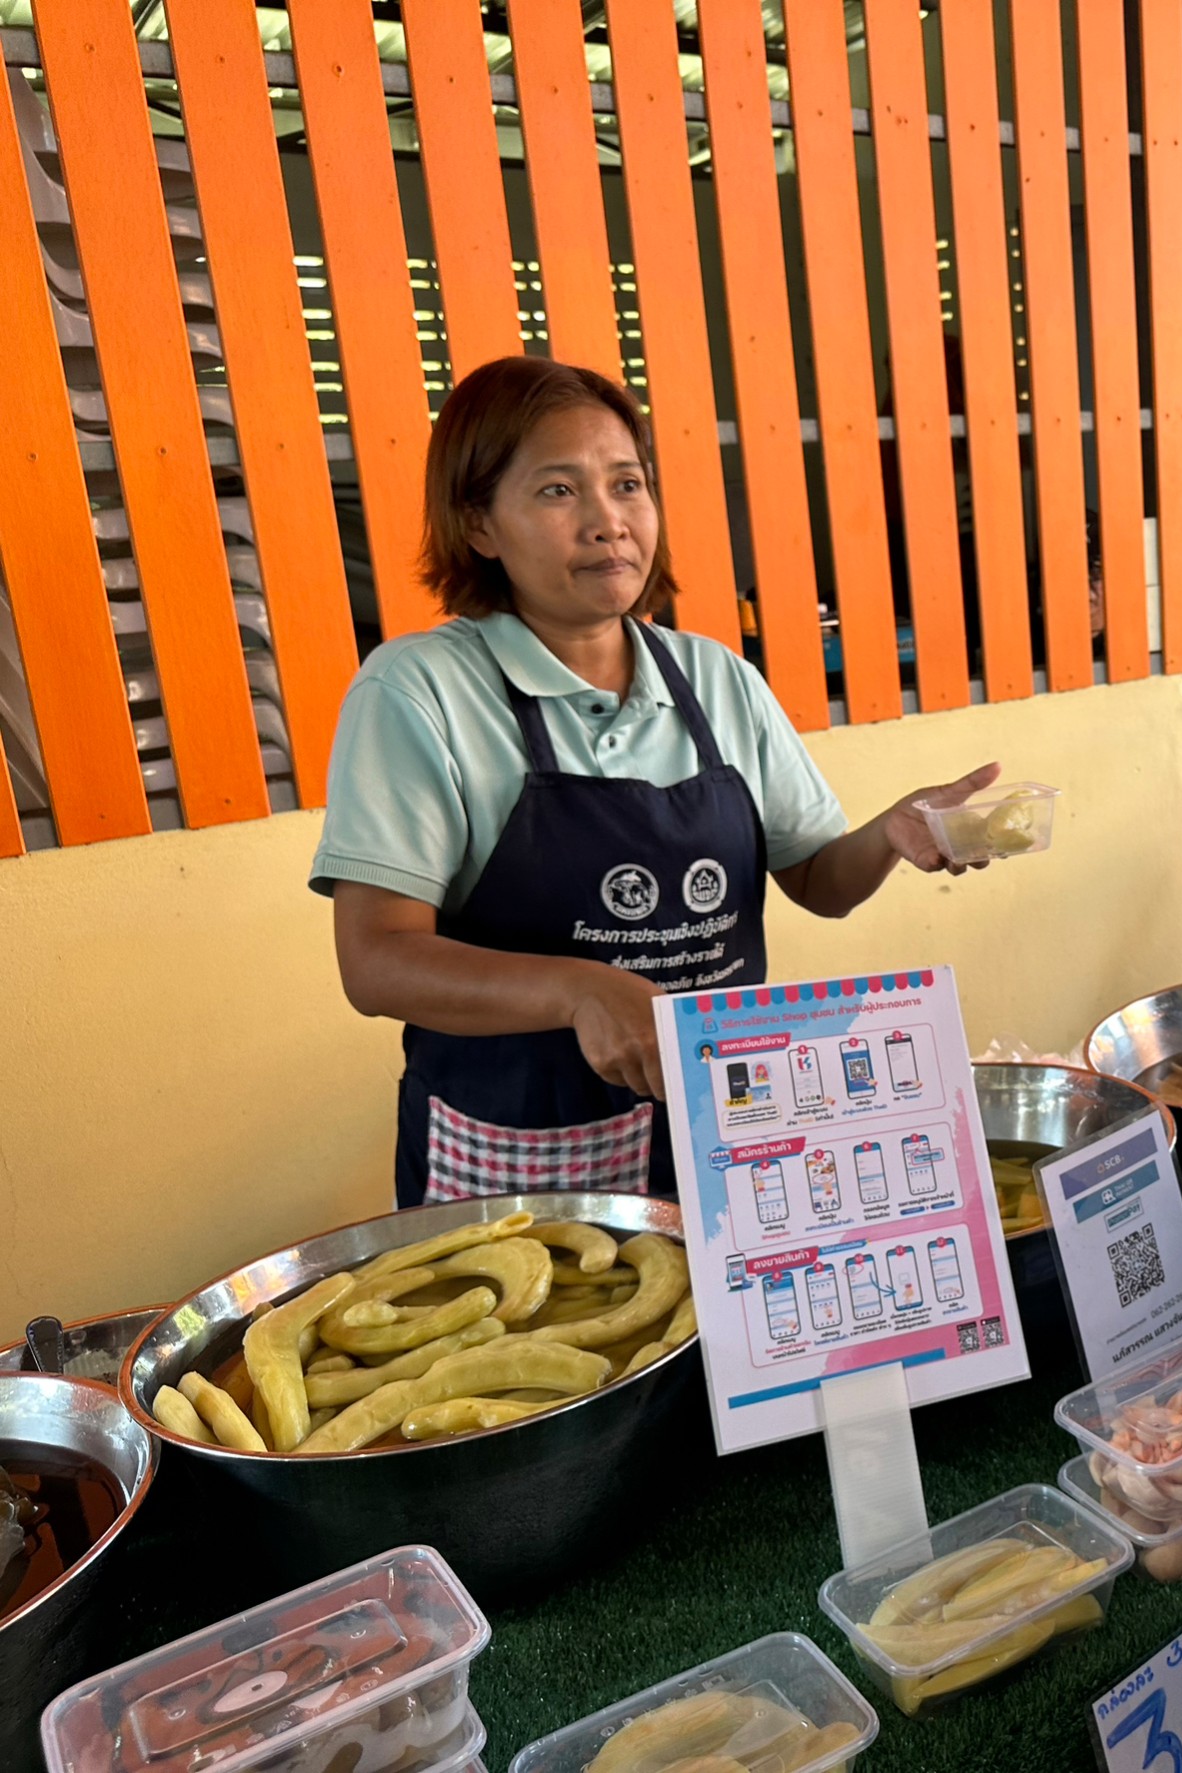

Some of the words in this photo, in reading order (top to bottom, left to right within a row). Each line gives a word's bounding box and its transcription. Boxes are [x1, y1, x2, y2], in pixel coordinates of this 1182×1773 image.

[782, 1012, 808, 1023] Shop
[721, 1036, 786, 1052] ลงทะเบียนใช้งาน
[737, 1141, 792, 1159] สมัครร้านค้า
[1104, 1154, 1121, 1170] SCB
[753, 1250, 811, 1270] ลงขายสินค้า
[1097, 1666, 1155, 1721] กล่องละ
